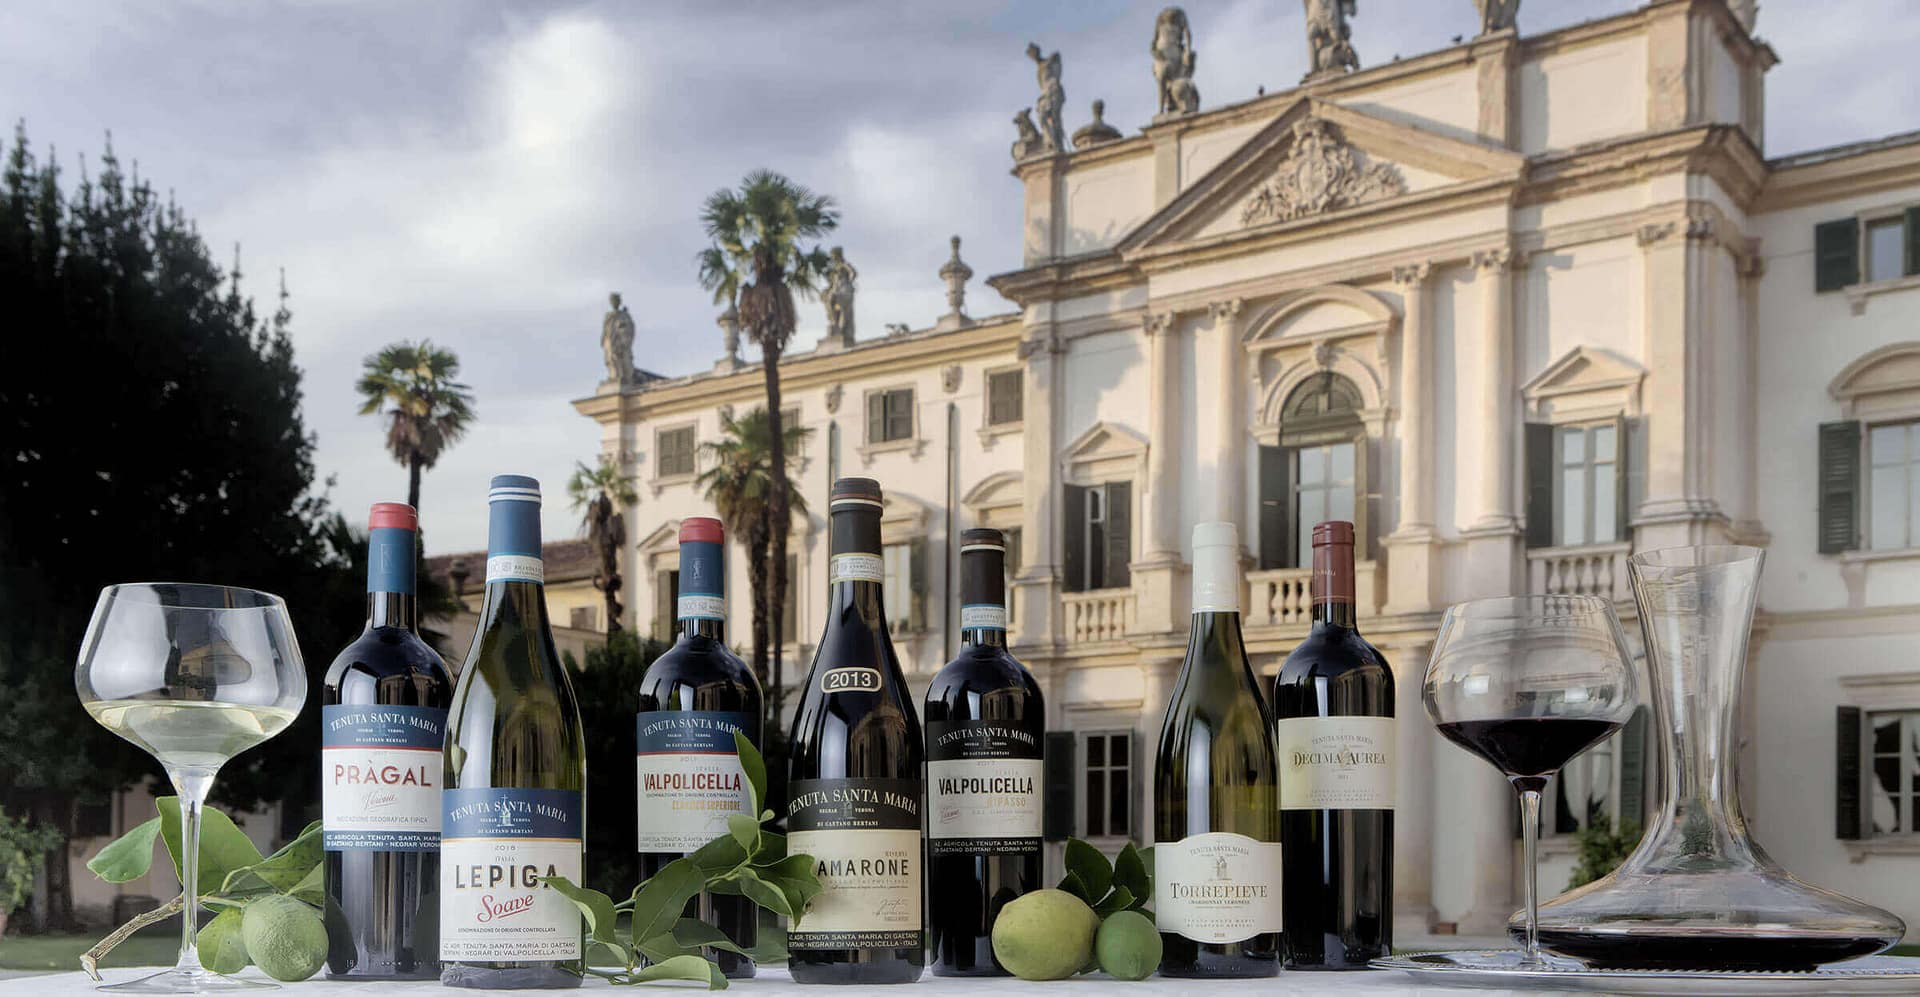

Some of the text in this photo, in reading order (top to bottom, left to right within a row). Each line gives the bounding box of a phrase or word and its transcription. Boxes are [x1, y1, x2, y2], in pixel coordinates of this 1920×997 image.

[830, 671, 871, 688] 2013
[330, 712, 438, 735] TENUTA SANTA MARIA
[643, 719, 676, 737] TENUTA
[679, 718, 713, 729] SANTA
[938, 727, 1034, 746] TENUTA SANTA MARIA
[1294, 751, 1386, 767] DECIMA AUREA
[335, 759, 432, 787] PRÀGAL
[643, 773, 741, 791] VALPOLICELLA
[938, 777, 1033, 796] VALPOLICELLA
[450, 800, 568, 823] TENUTA SANTA MARIA
[788, 788, 917, 817] TENUTA SANTA MARIA
[817, 859, 909, 876] AMARONE
[1170, 882, 1268, 899] TORREPIEVE
[477, 894, 534, 922] Soave
[846, 940, 899, 948] VALPOLICELLA
